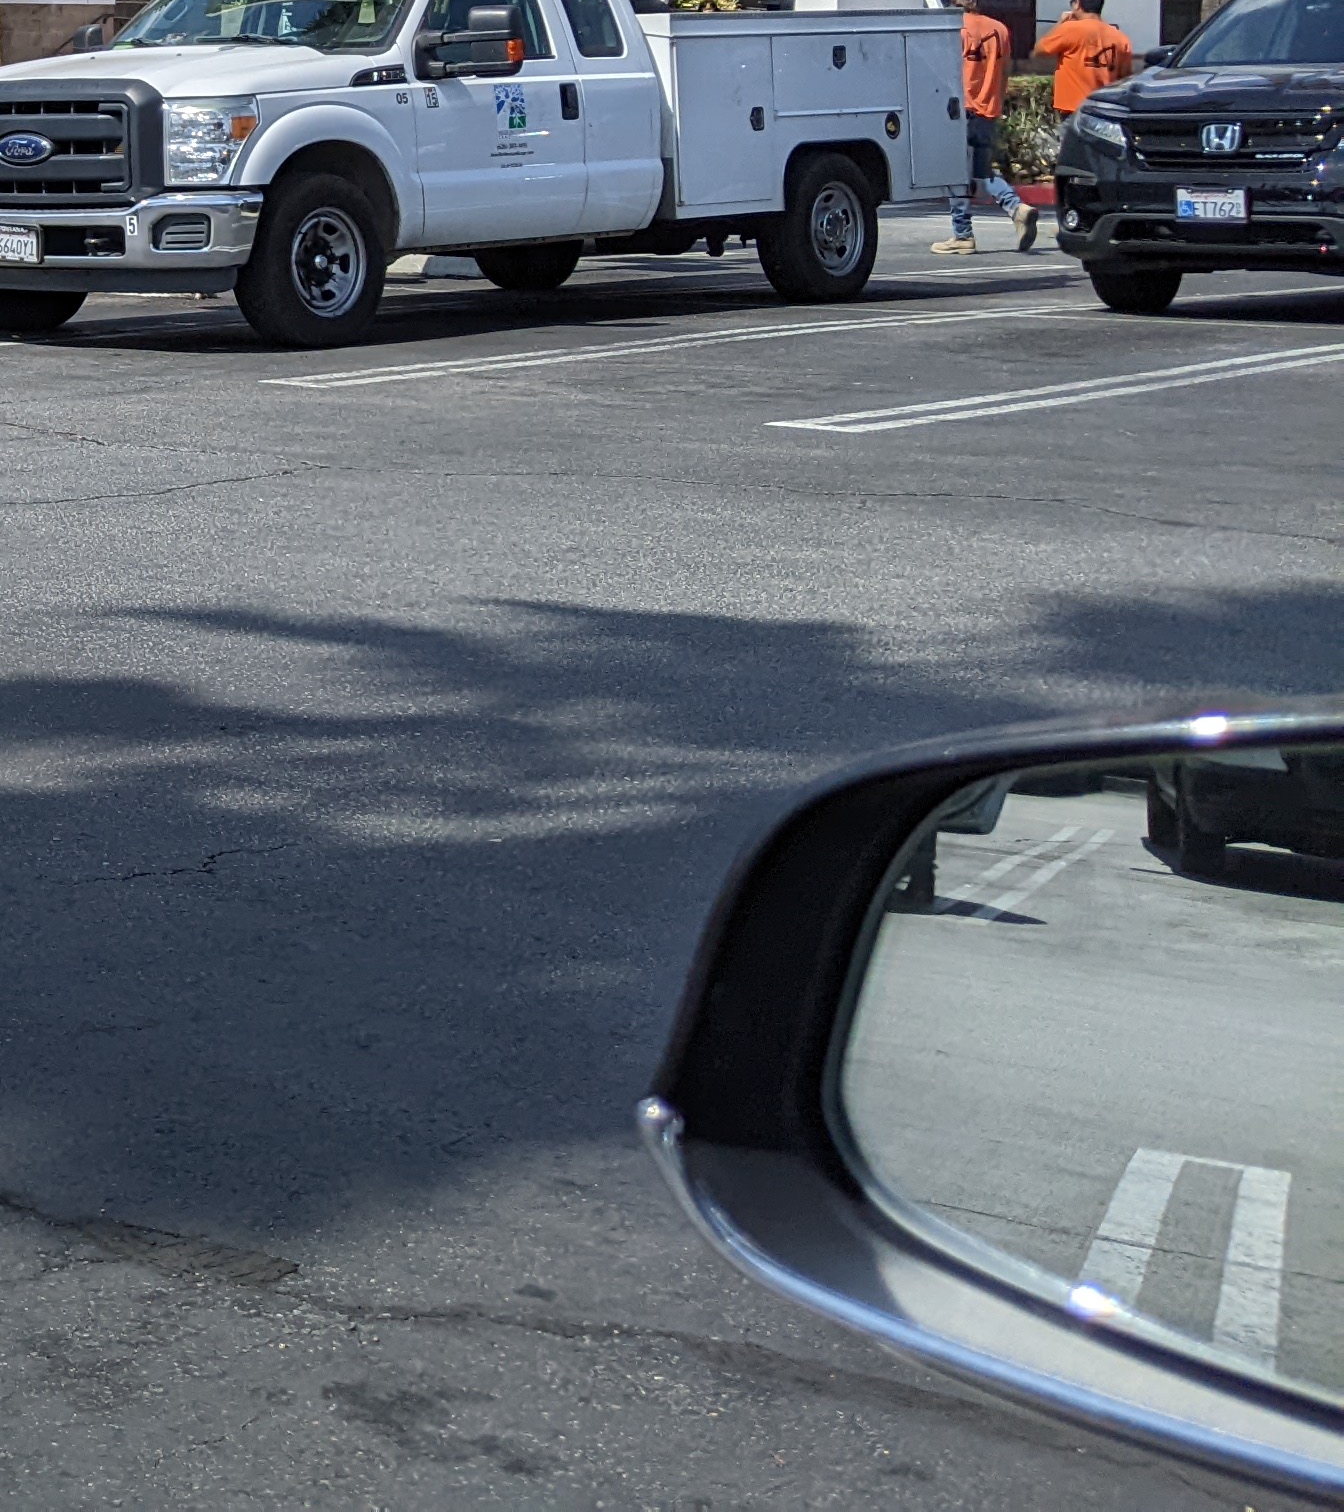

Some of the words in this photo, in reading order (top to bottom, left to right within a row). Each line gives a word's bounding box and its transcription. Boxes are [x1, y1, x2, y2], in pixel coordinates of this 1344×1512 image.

[396, 92, 409, 105] 05
[426, 93, 438, 108] 15
[1193, 202, 1235, 218] ET762
[128, 217, 137, 235] 5
